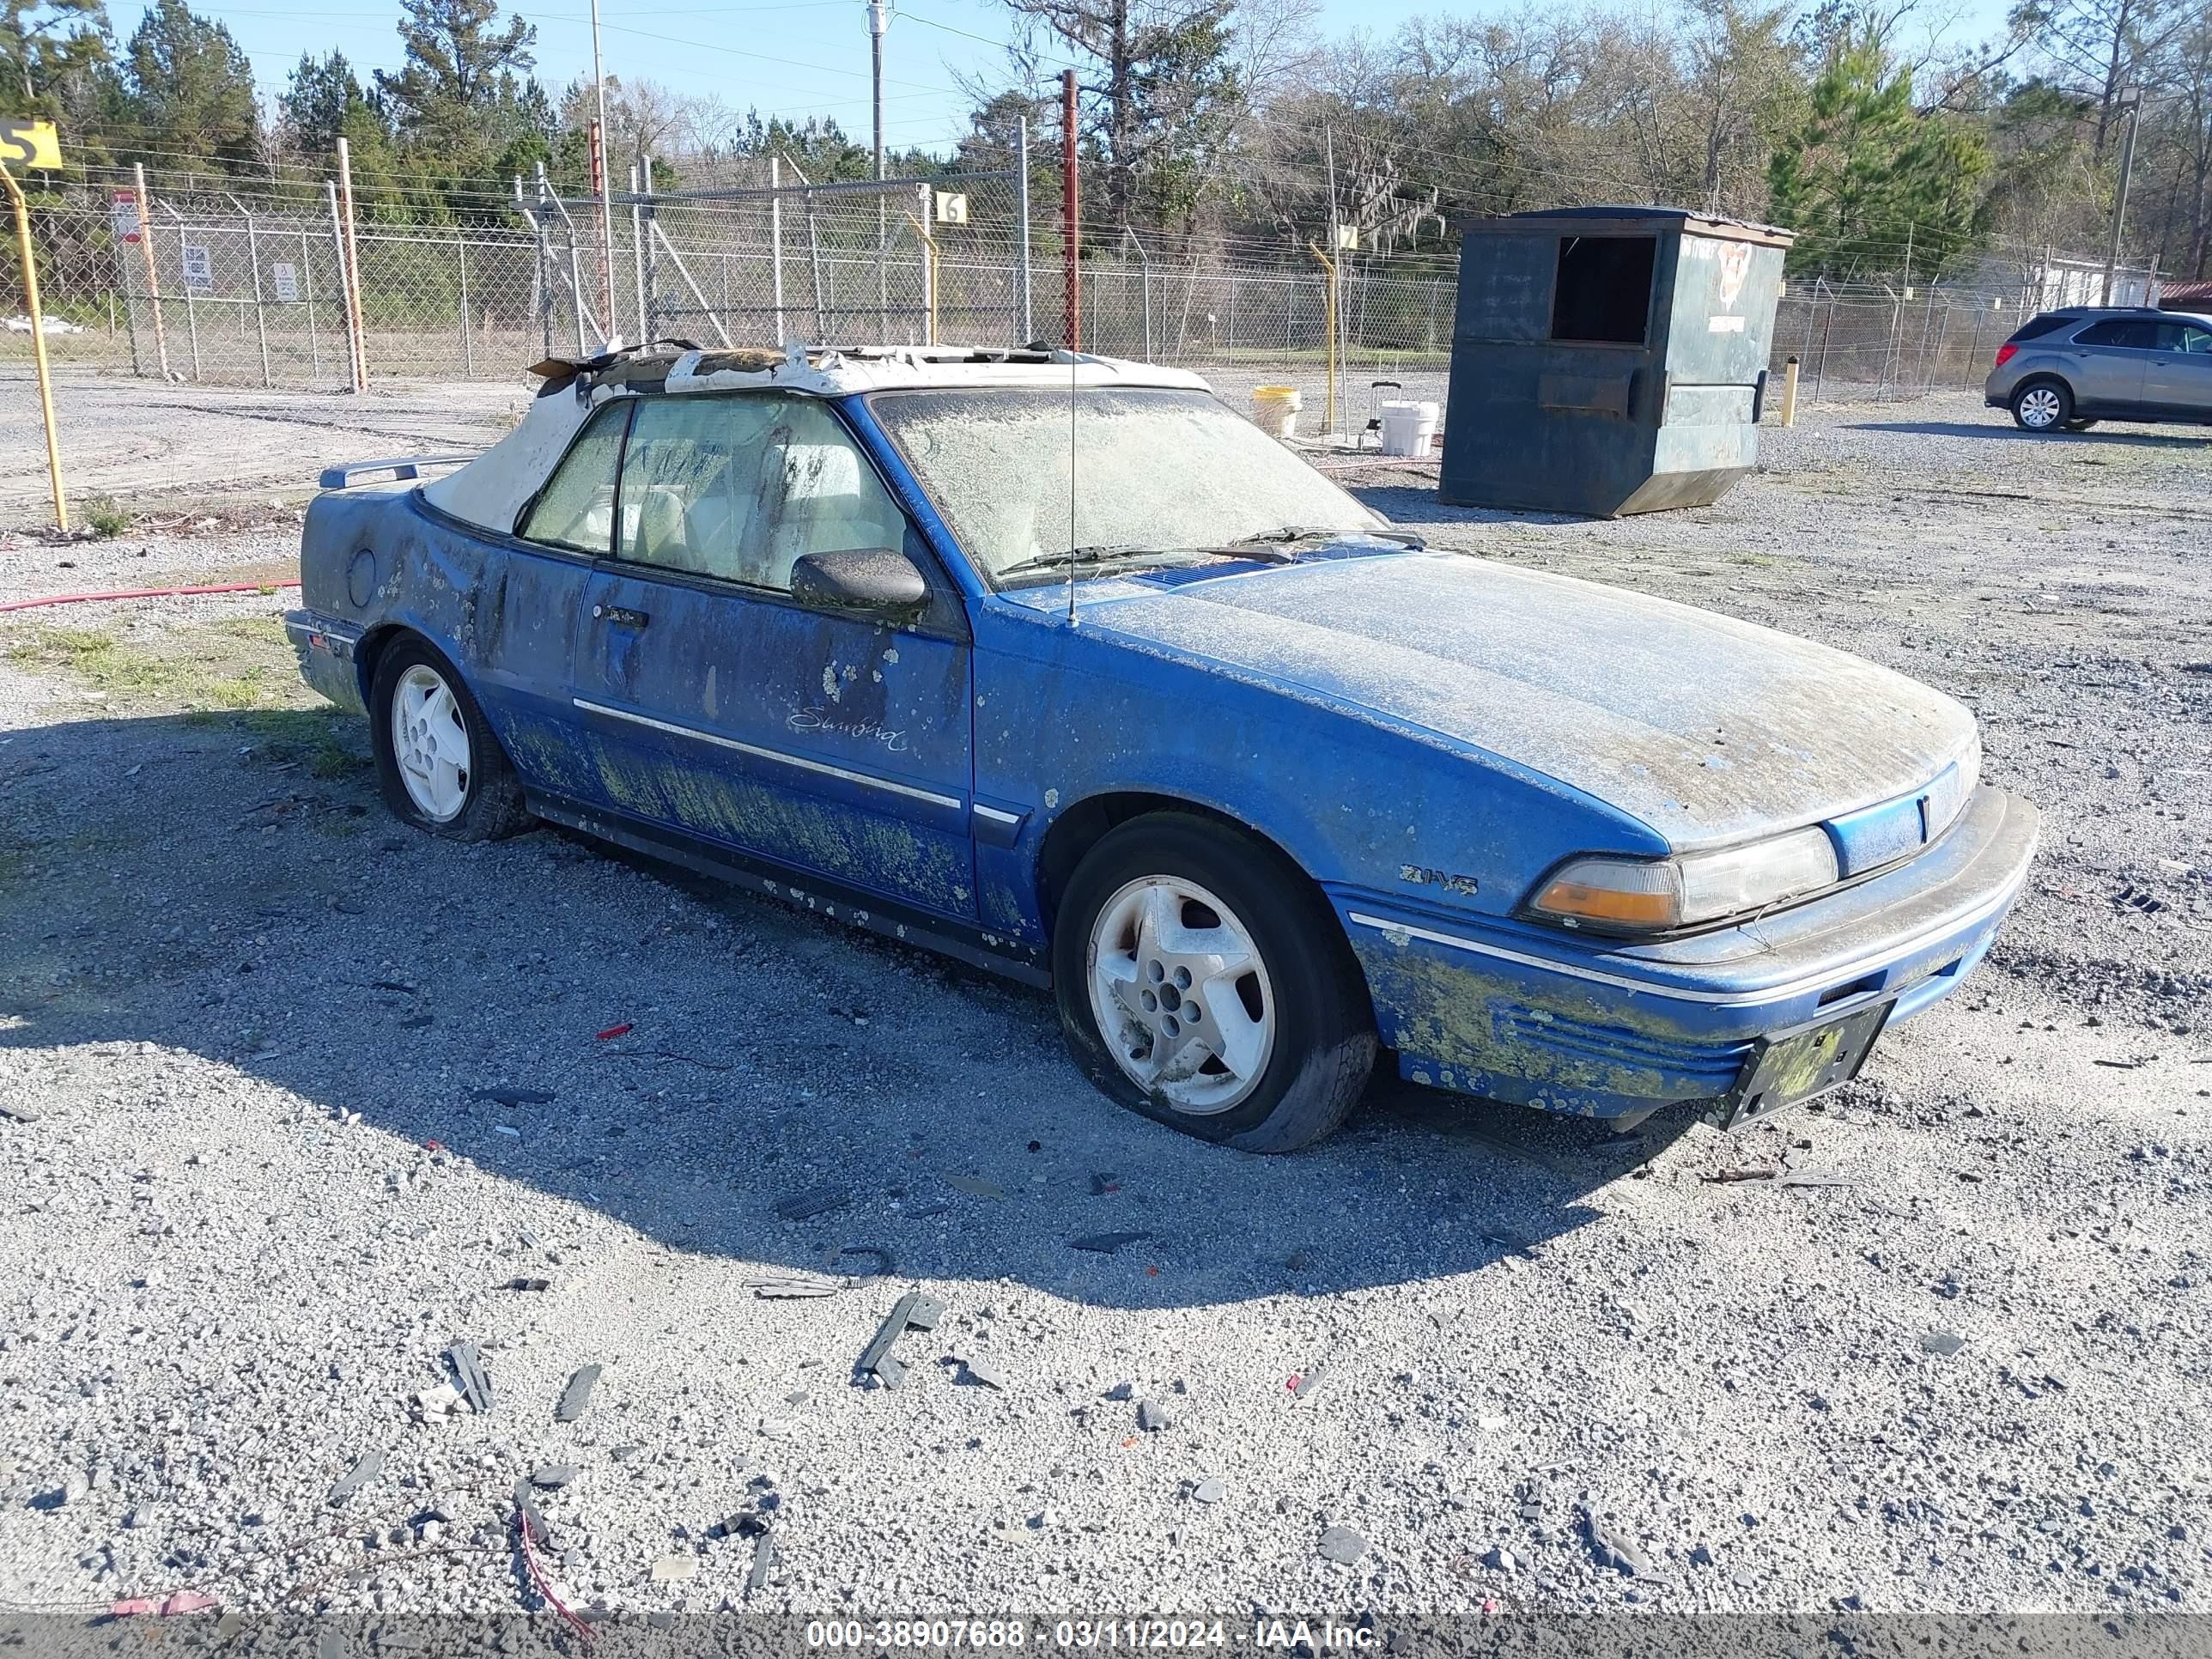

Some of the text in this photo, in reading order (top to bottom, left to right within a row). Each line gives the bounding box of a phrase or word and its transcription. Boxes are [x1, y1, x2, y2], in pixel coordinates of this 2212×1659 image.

[0, 118, 38, 166] 5
[945, 193, 960, 222] 6
[1343, 225, 1354, 247] 7
[789, 705, 908, 751] Sunbird
